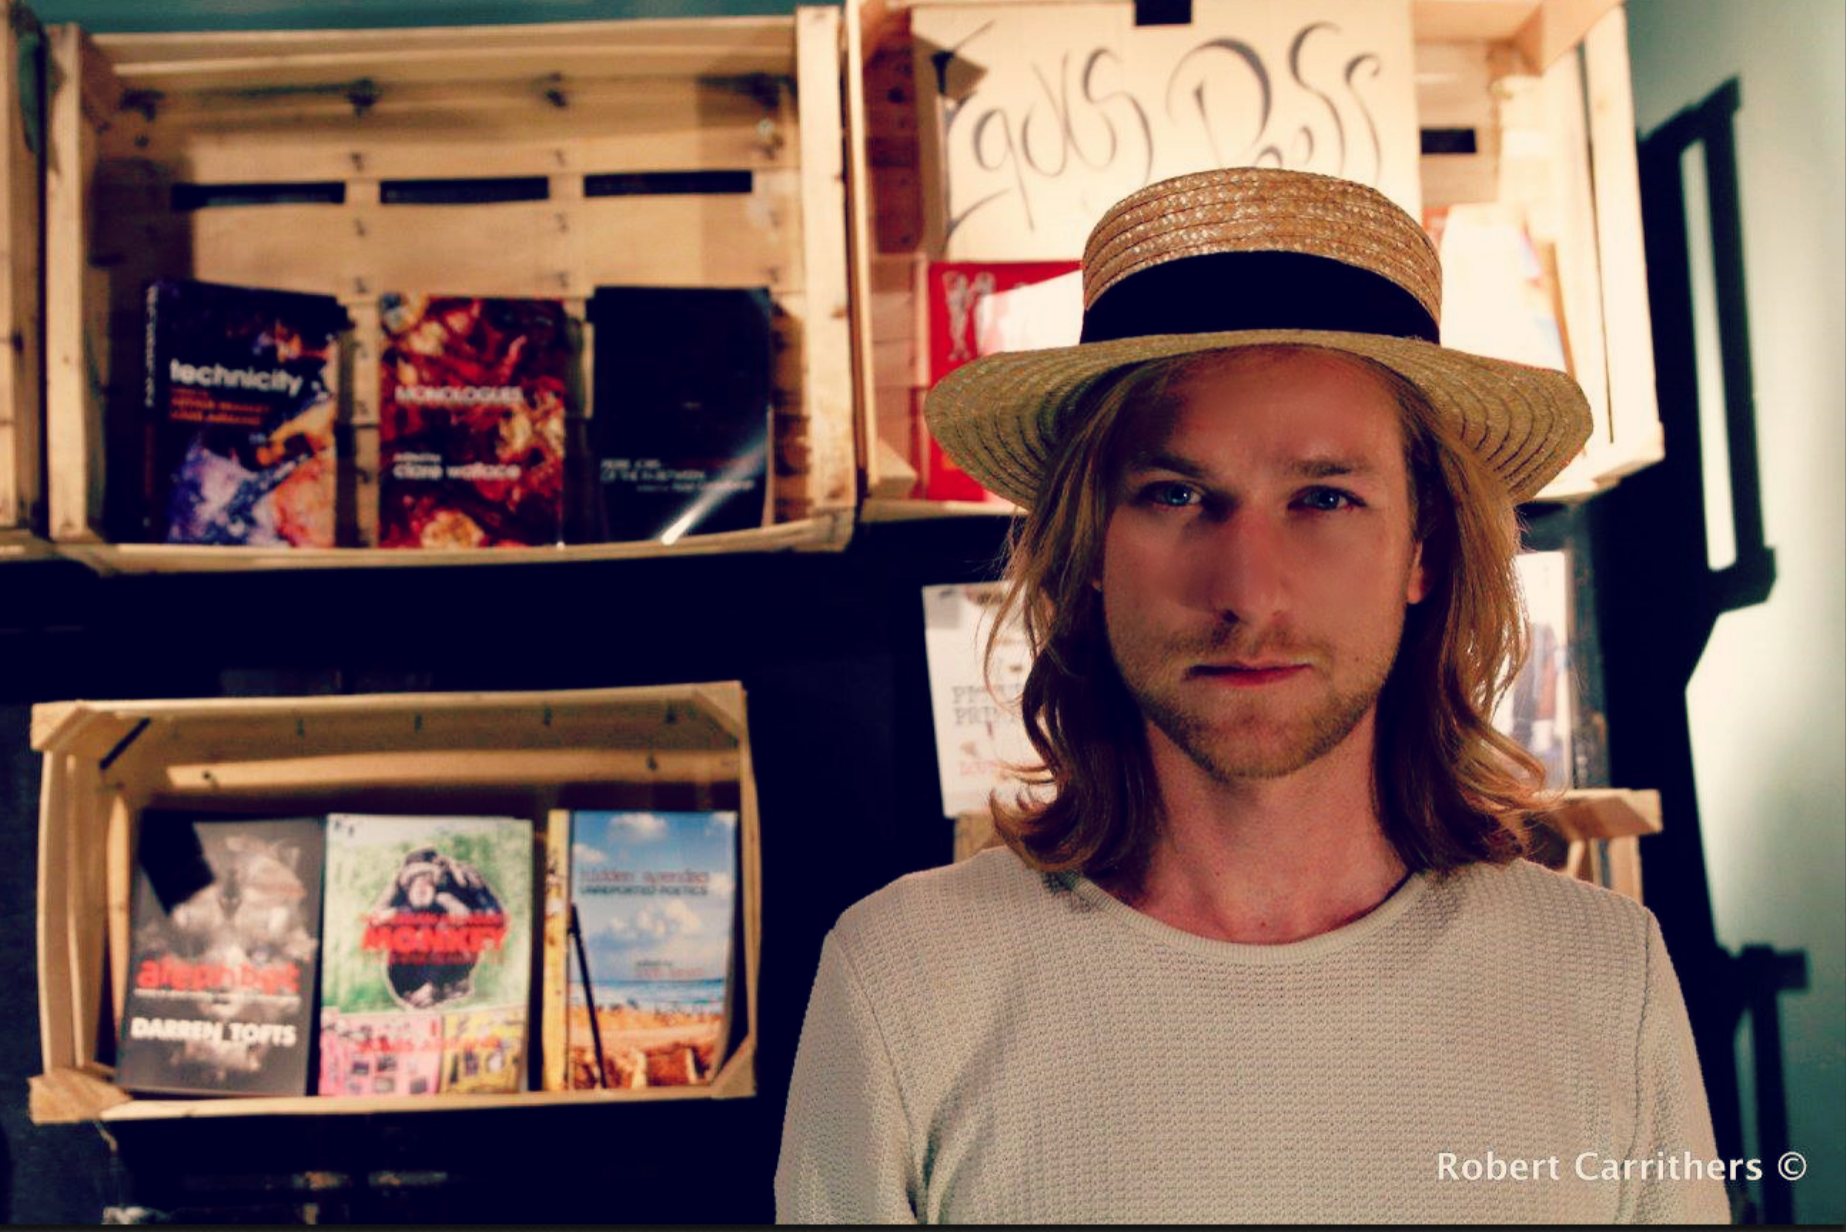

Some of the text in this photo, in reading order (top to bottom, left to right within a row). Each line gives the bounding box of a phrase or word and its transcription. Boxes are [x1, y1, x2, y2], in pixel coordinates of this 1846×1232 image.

[170, 358, 303, 398] technicity
[131, 1016, 298, 1048] DARREN TOFTS
